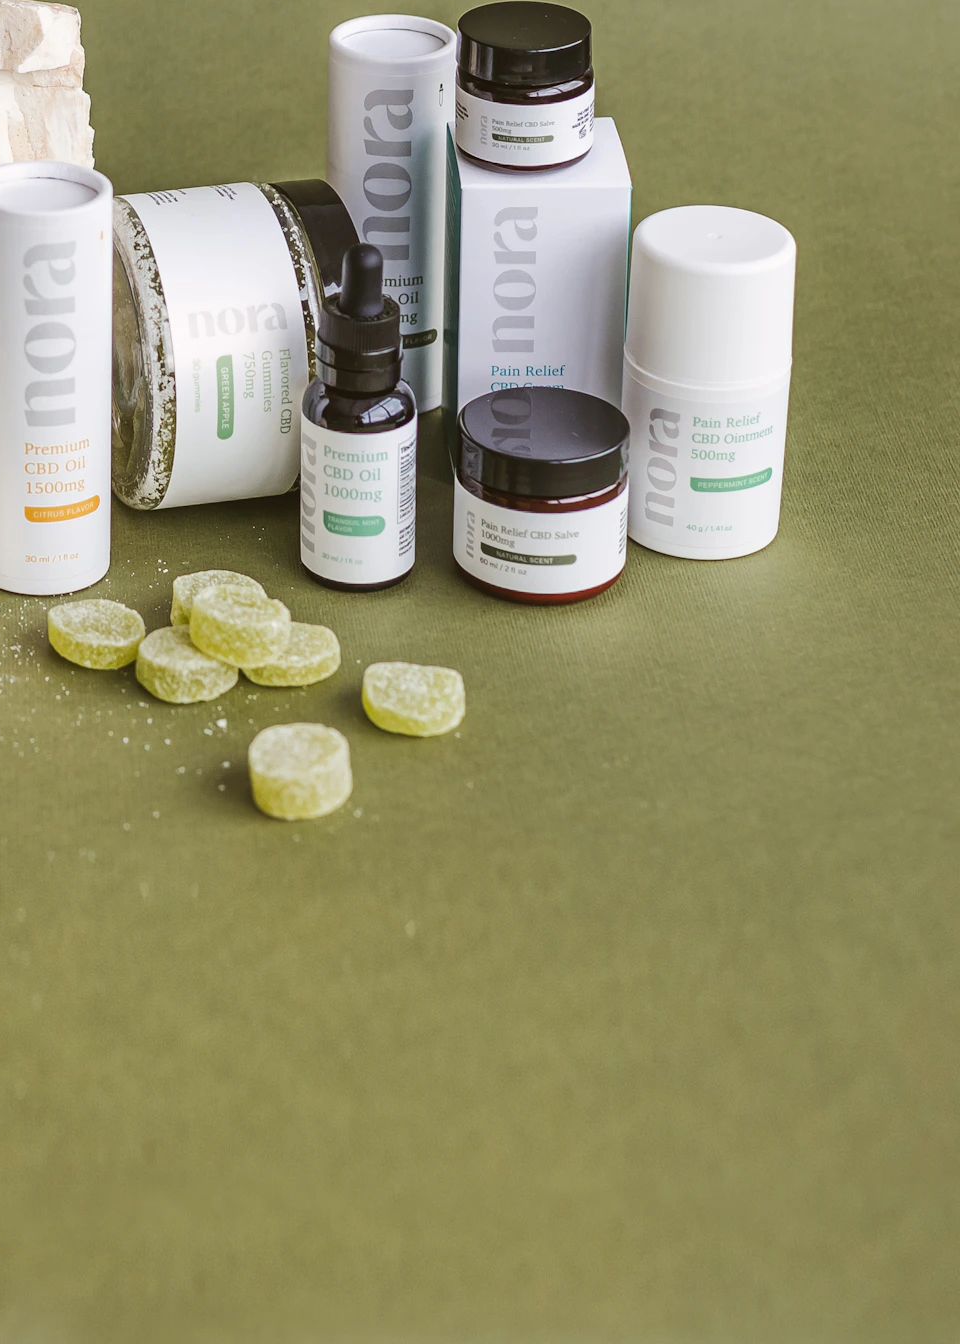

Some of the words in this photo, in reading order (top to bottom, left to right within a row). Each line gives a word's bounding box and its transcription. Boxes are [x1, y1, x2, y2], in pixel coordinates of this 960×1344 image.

[480, 115, 488, 146] nora
[492, 118, 504, 126] Pain
[539, 119, 555, 127] Salve
[362, 88, 414, 261] nora
[492, 206, 538, 352] nora
[398, 291, 419, 305] Oil
[187, 302, 288, 339] nora
[23, 240, 77, 427] nora
[243, 352, 256, 399] 750mg
[279, 348, 293, 405] Flavored
[491, 365, 520, 376] Pain
[525, 364, 566, 376] Relief
[221, 367, 230, 399] GREEN
[262, 350, 275, 413] Gummies
[193, 373, 202, 413] gummies
[221, 401, 229, 429] APPLE
[280, 409, 292, 435] CBD
[692, 416, 721, 428] Pain
[726, 412, 761, 428] Relief
[692, 433, 720, 444] CBD
[724, 425, 774, 444] Ointment
[24, 438, 90, 455] Premium
[323, 445, 388, 463] Premium
[691, 448, 736, 463] 500mg
[24, 462, 59, 475] CBD
[65, 456, 86, 472] Oil
[323, 464, 354, 481] CBD
[359, 468, 382, 482] Oil
[644, 408, 681, 527] nora
[26, 479, 85, 494] 1500mg
[697, 479, 747, 488] PEPPERMINT
[748, 472, 768, 485] SCENT
[324, 483, 383, 503] 1000mg
[33, 510, 64, 519] CITRUS
[67, 502, 94, 515] FLAVOR
[465, 510, 476, 558] nora
[481, 518, 498, 532] Pain
[501, 525, 528, 538] Relief
[530, 531, 552, 540] CBD
[554, 530, 579, 540] Salve
[481, 529, 515, 548] 1000mg
[25, 555, 37, 563] 30
[496, 550, 527, 563] NATURAL
